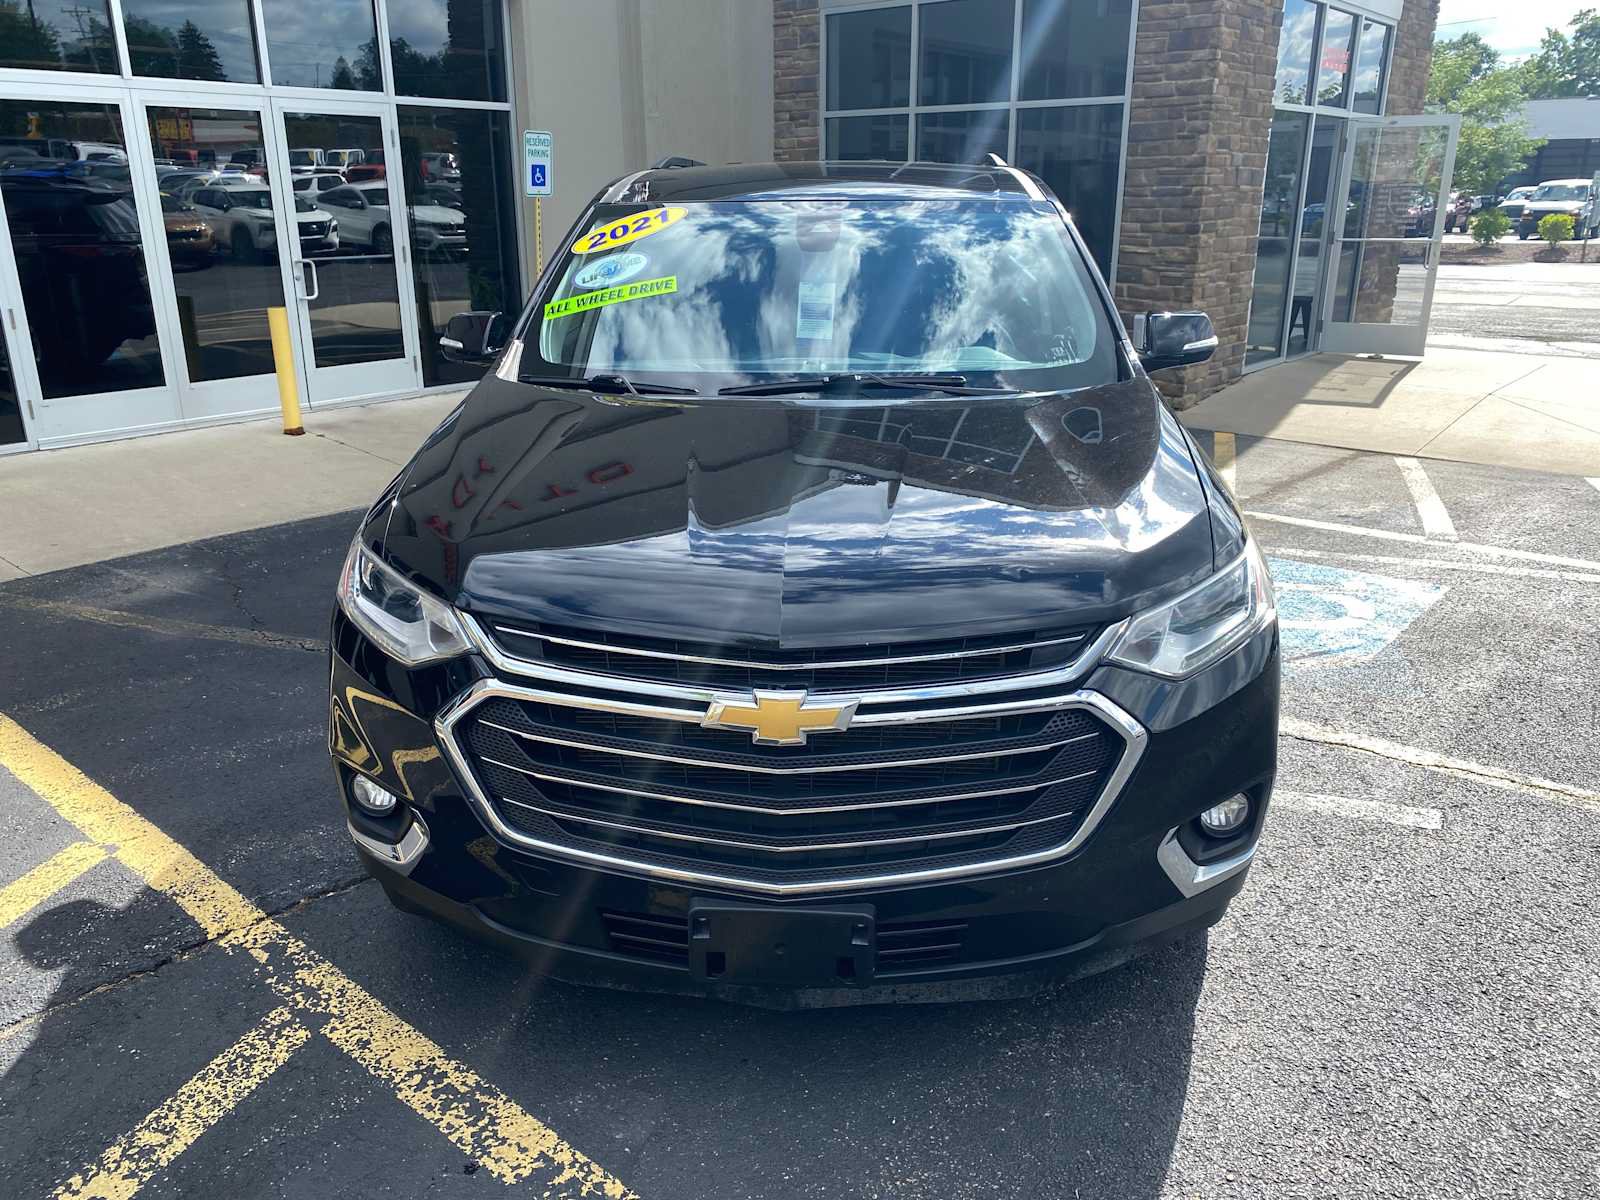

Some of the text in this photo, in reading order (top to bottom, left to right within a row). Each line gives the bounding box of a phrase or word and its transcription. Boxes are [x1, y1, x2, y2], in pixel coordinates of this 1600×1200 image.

[526, 136, 550, 147] RESERVED
[527, 149, 549, 158] PARKING
[587, 209, 669, 250] 2021
[546, 278, 674, 317] ALL WHEEL DRIVE
